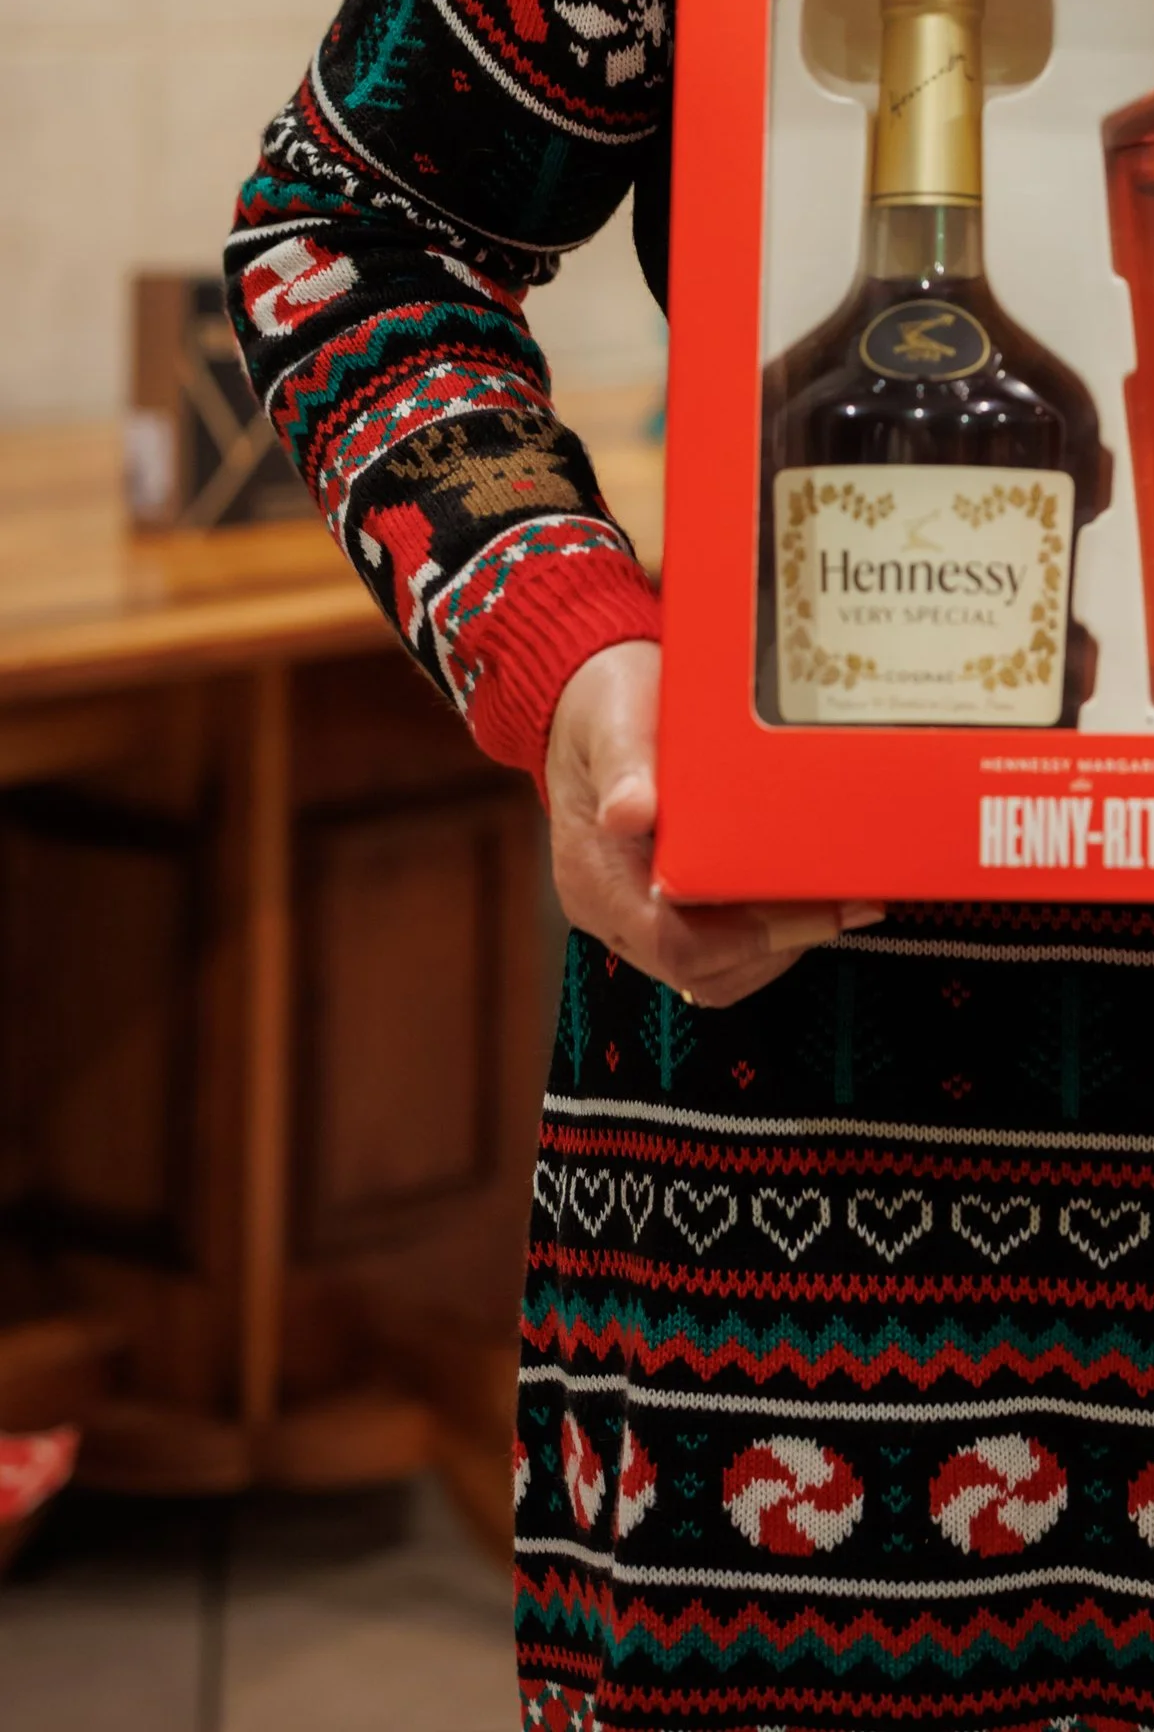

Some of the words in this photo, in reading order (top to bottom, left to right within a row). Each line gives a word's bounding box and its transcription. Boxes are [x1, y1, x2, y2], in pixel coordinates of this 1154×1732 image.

[819, 549, 1027, 607] Hennessy
[836, 606, 894, 626] VERY
[903, 606, 998, 627] SPECIAL
